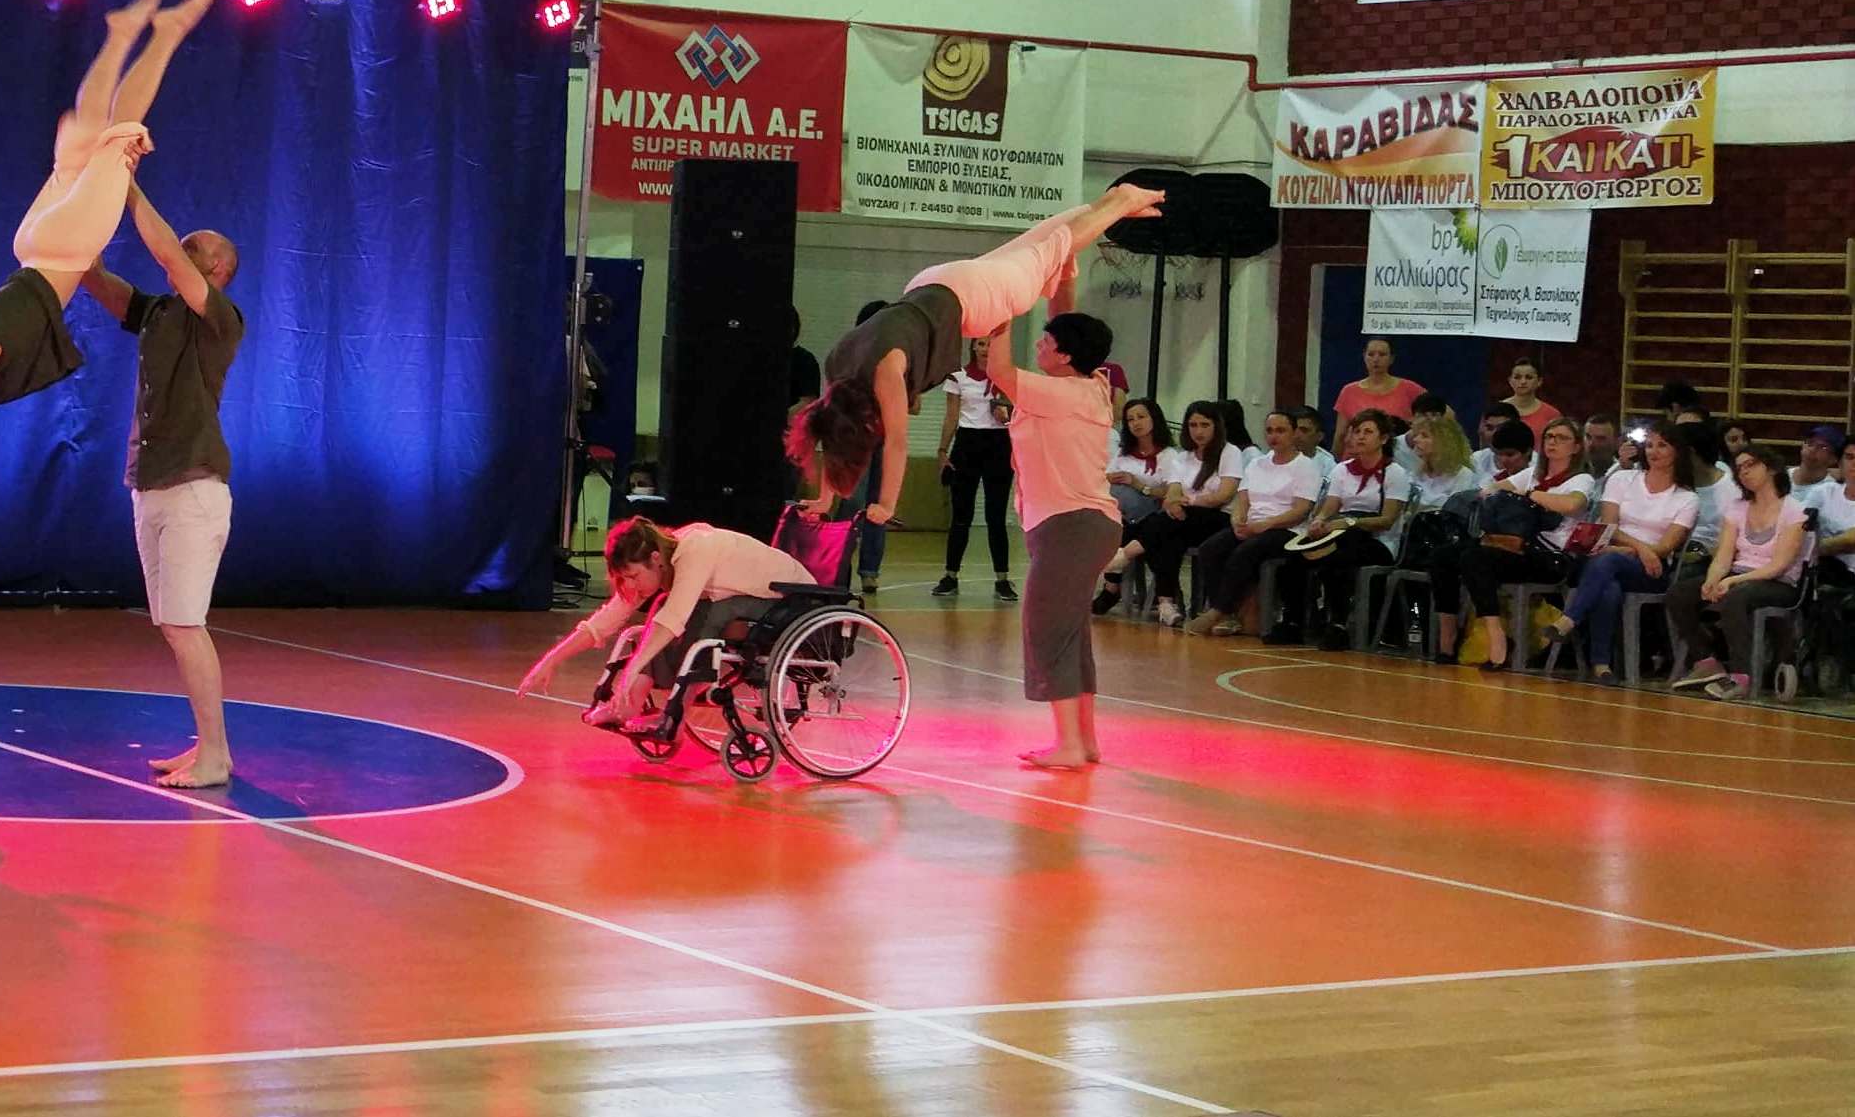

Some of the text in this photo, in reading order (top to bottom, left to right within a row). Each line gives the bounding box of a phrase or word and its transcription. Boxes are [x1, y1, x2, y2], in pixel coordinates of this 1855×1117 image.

[601, 88, 823, 140] ΜΙΧΑΗΛ Α.Ε.
[926, 107, 999, 135] TSIGAS
[1290, 91, 1479, 161] ΚΑΡΑΒΙΔΑΣ
[1499, 110, 1632, 127] ΠΑΡΑΔΟΣΙΑΚΑ
[632, 135, 795, 161] SUPER MARKET
[856, 136, 1064, 166] ΒΙΟΜΗΧΑΝΙΑ ΞΥΛΙΝΩΝ ΚΟΥΦΩΜΑΤΩΝ
[1603, 134, 1693, 169] ΚΑΤΙ
[908, 159, 960, 176] ΕΜΠΟΡΙΟ
[856, 172, 1063, 201] ΟΙΚΟΔΟΜΙΚΩΝ & ΜΟΝΩΤΙΚΩΝ ΥΛΙΚΩΝ
[1278, 174, 1475, 205] ΚΟΥΖΙΝΑ ΝΤΟΥΛΑΠΑ ΠΟΡΤΑ
[1432, 223, 1452, 256] bp
[1374, 259, 1470, 295] καλλιώρας
